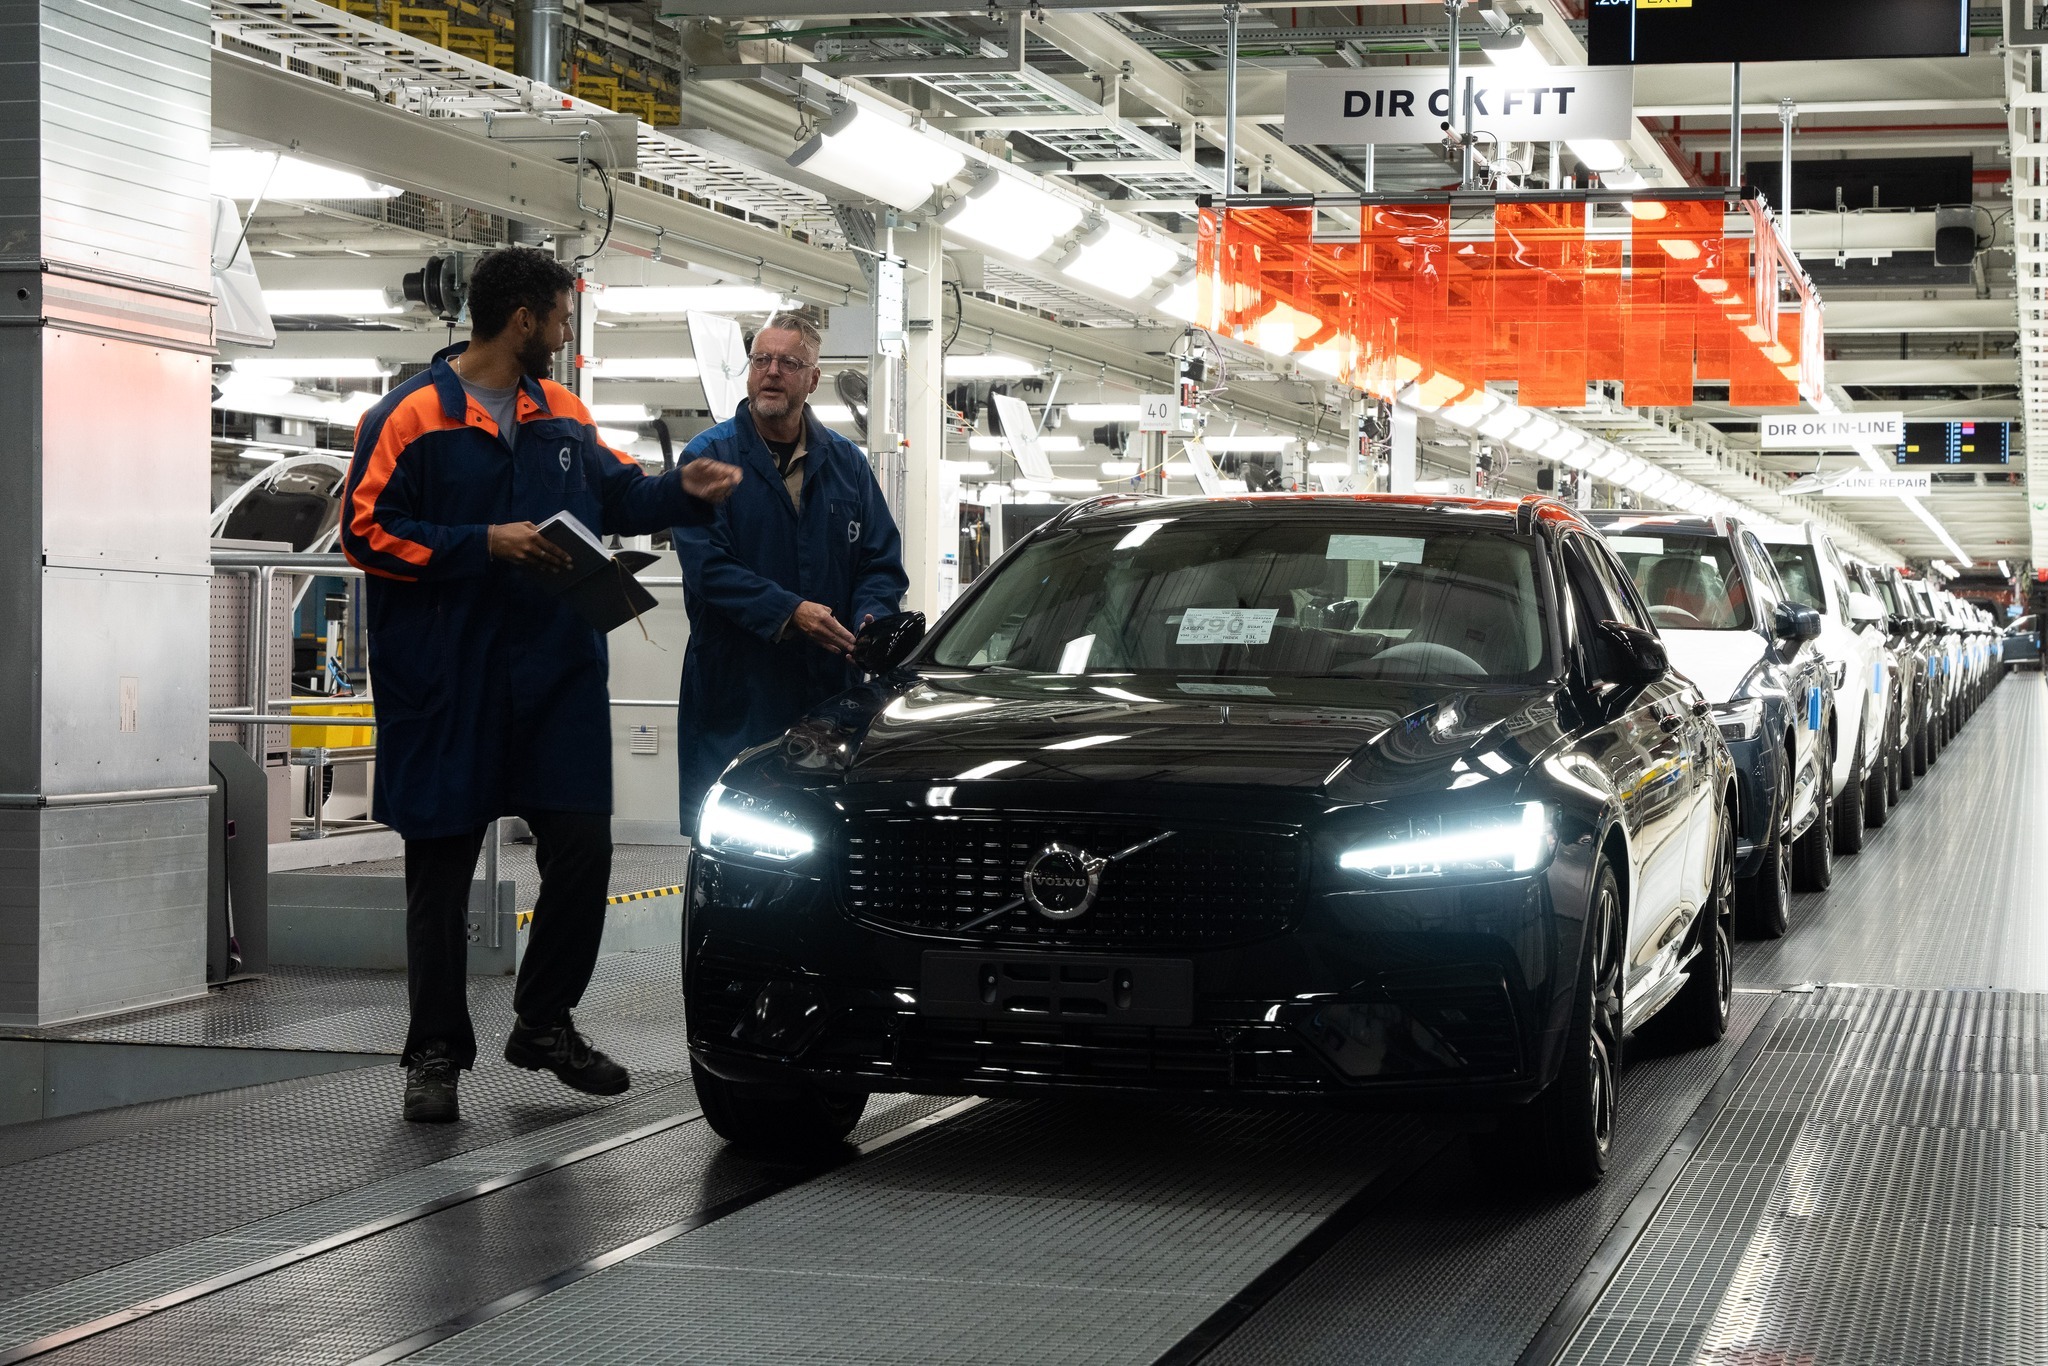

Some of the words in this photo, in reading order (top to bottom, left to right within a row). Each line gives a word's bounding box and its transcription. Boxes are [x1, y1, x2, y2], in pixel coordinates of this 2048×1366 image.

[1343, 90, 1415, 118] DIR
[1427, 88, 1489, 117] OK
[1502, 86, 1576, 115] FTT
[1147, 402, 1168, 419] 40
[1768, 423, 1797, 436] DIR
[1802, 422, 1827, 435] OK
[1832, 420, 1897, 434] IN-LINE
[1452, 483, 1465, 494] 36
[1879, 478, 1927, 488] REPAIR
[1186, 617, 1245, 634] V90
[1033, 876, 1087, 887] VOLVO
